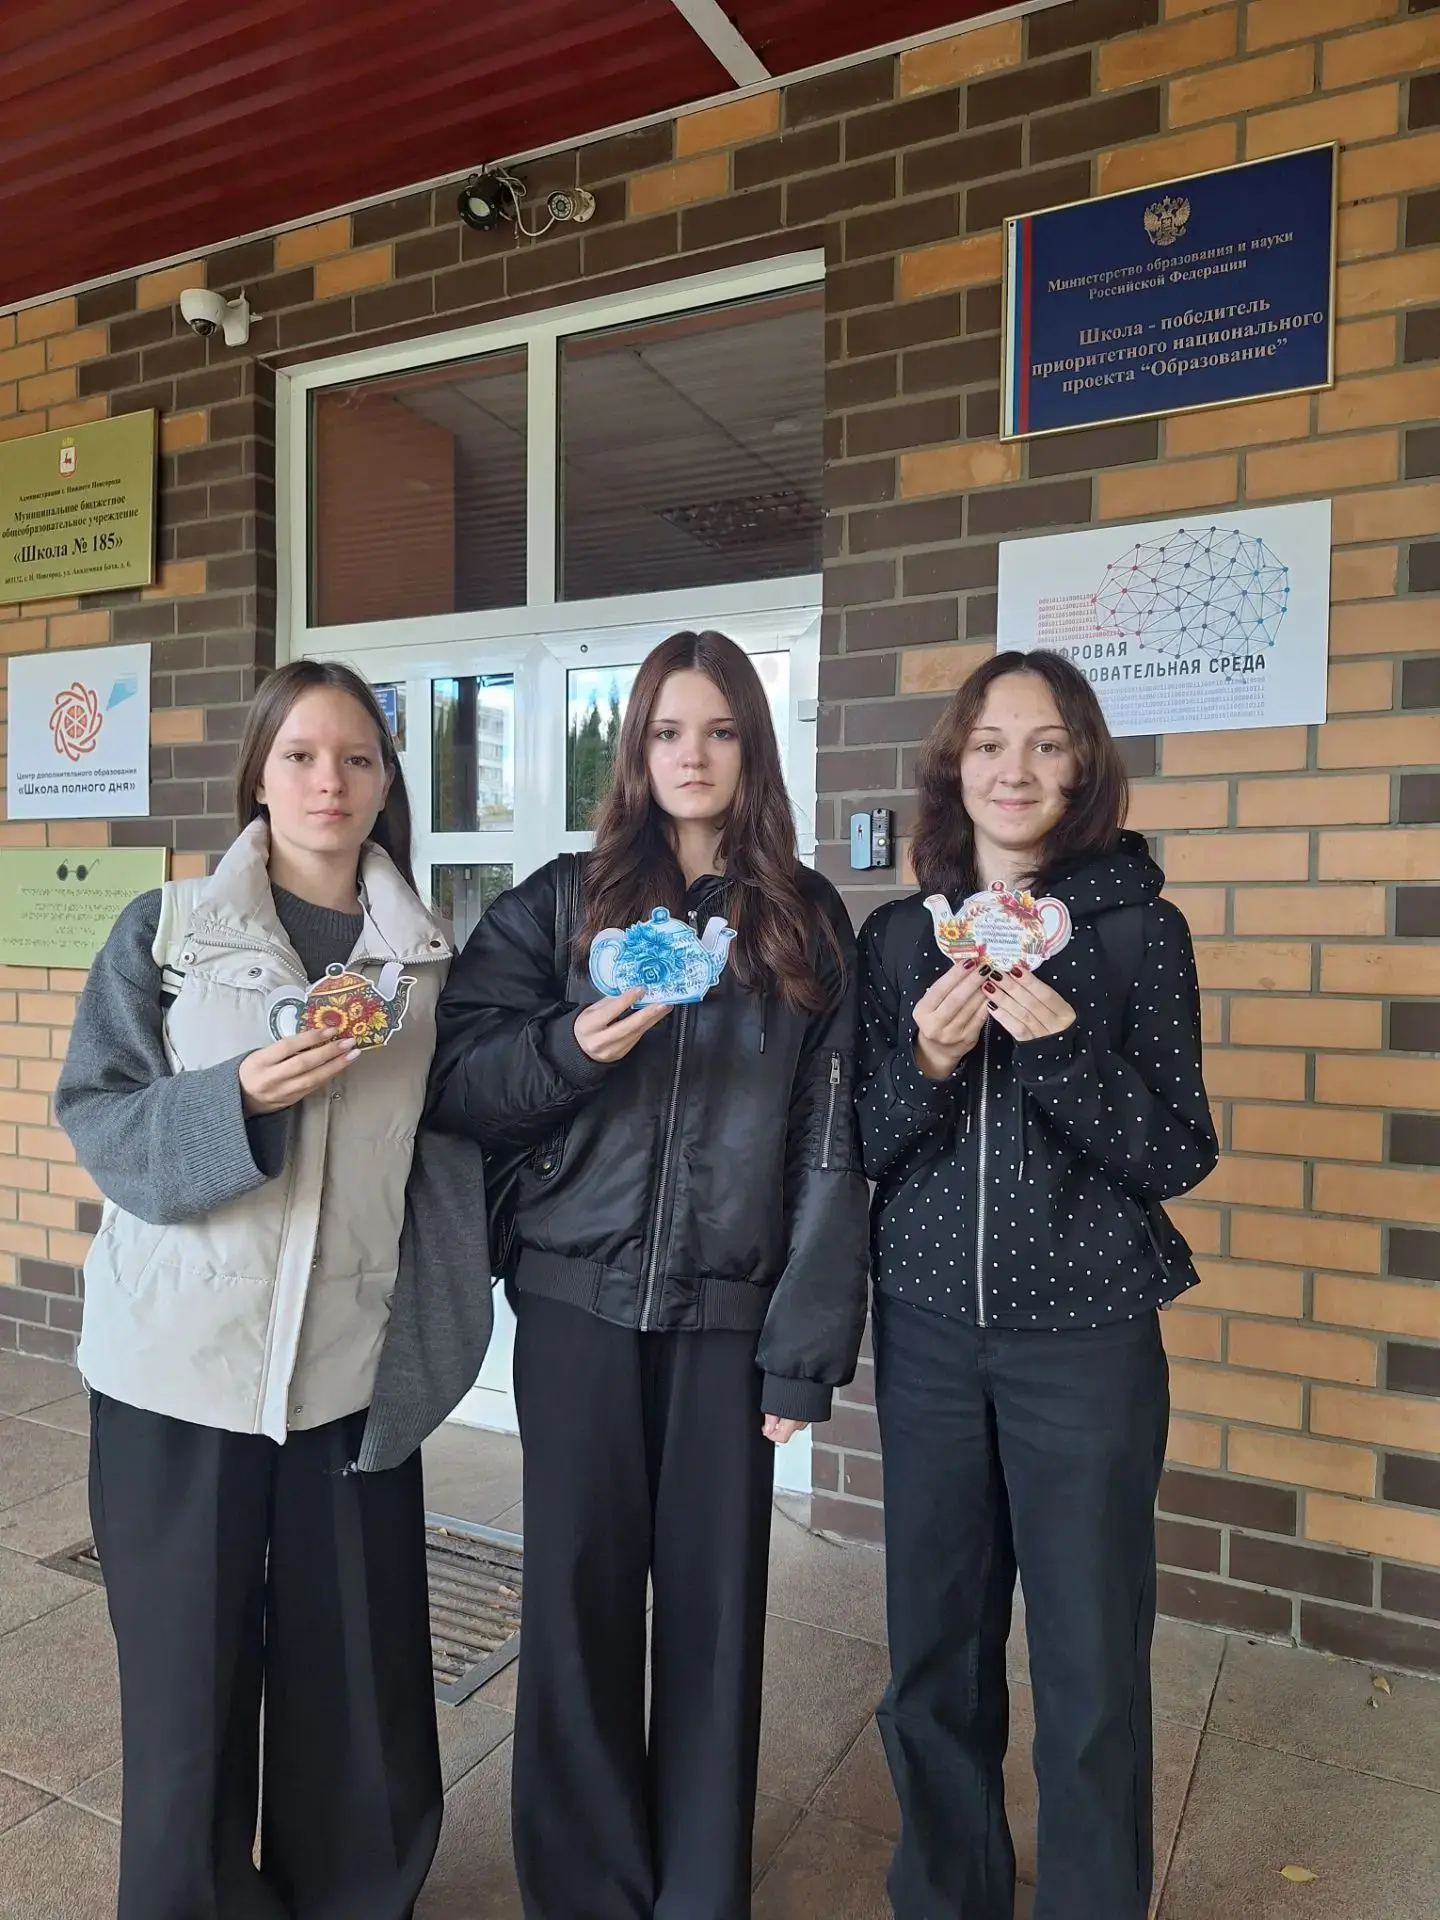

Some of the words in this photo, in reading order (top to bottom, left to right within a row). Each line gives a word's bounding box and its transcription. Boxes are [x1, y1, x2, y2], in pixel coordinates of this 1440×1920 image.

[1048, 264, 1143, 293] Министерство
[1146, 244, 1233, 272] образования
[1237, 242, 1246, 253] и
[1250, 231, 1294, 250] науки
[1089, 274, 1165, 300] Российской
[1169, 258, 1247, 285] Федерации
[1080, 323, 1143, 346] Школа
[1161, 298, 1271, 331] победитель
[1032, 341, 1167, 378] приоритетного
[1173, 311, 1324, 351] национального
[1062, 369, 1135, 394] проекта
[2, 517, 87, 539] общеобразовательное
[88, 508, 139, 527] учреждение
[14, 503, 79, 524] Муниципальное
[80, 495, 126, 511] бюджетное
[13, 544, 68, 564] «Школа
[71, 537, 88, 555] №
[92, 532, 123, 552] 185»
[1047, 641, 1127, 662] ФРОВАЯ
[1080, 658, 1201, 683] ЗОВАТЕЛЬНАЯ
[1209, 654, 1266, 674] СРЕДА
[16, 772, 35, 780] Центр
[36, 769, 92, 779] дополнительного
[94, 767, 137, 777] образования
[18, 783, 59, 795] «Школа
[61, 782, 106, 793] полного
[108, 781, 136, 792] дня»
